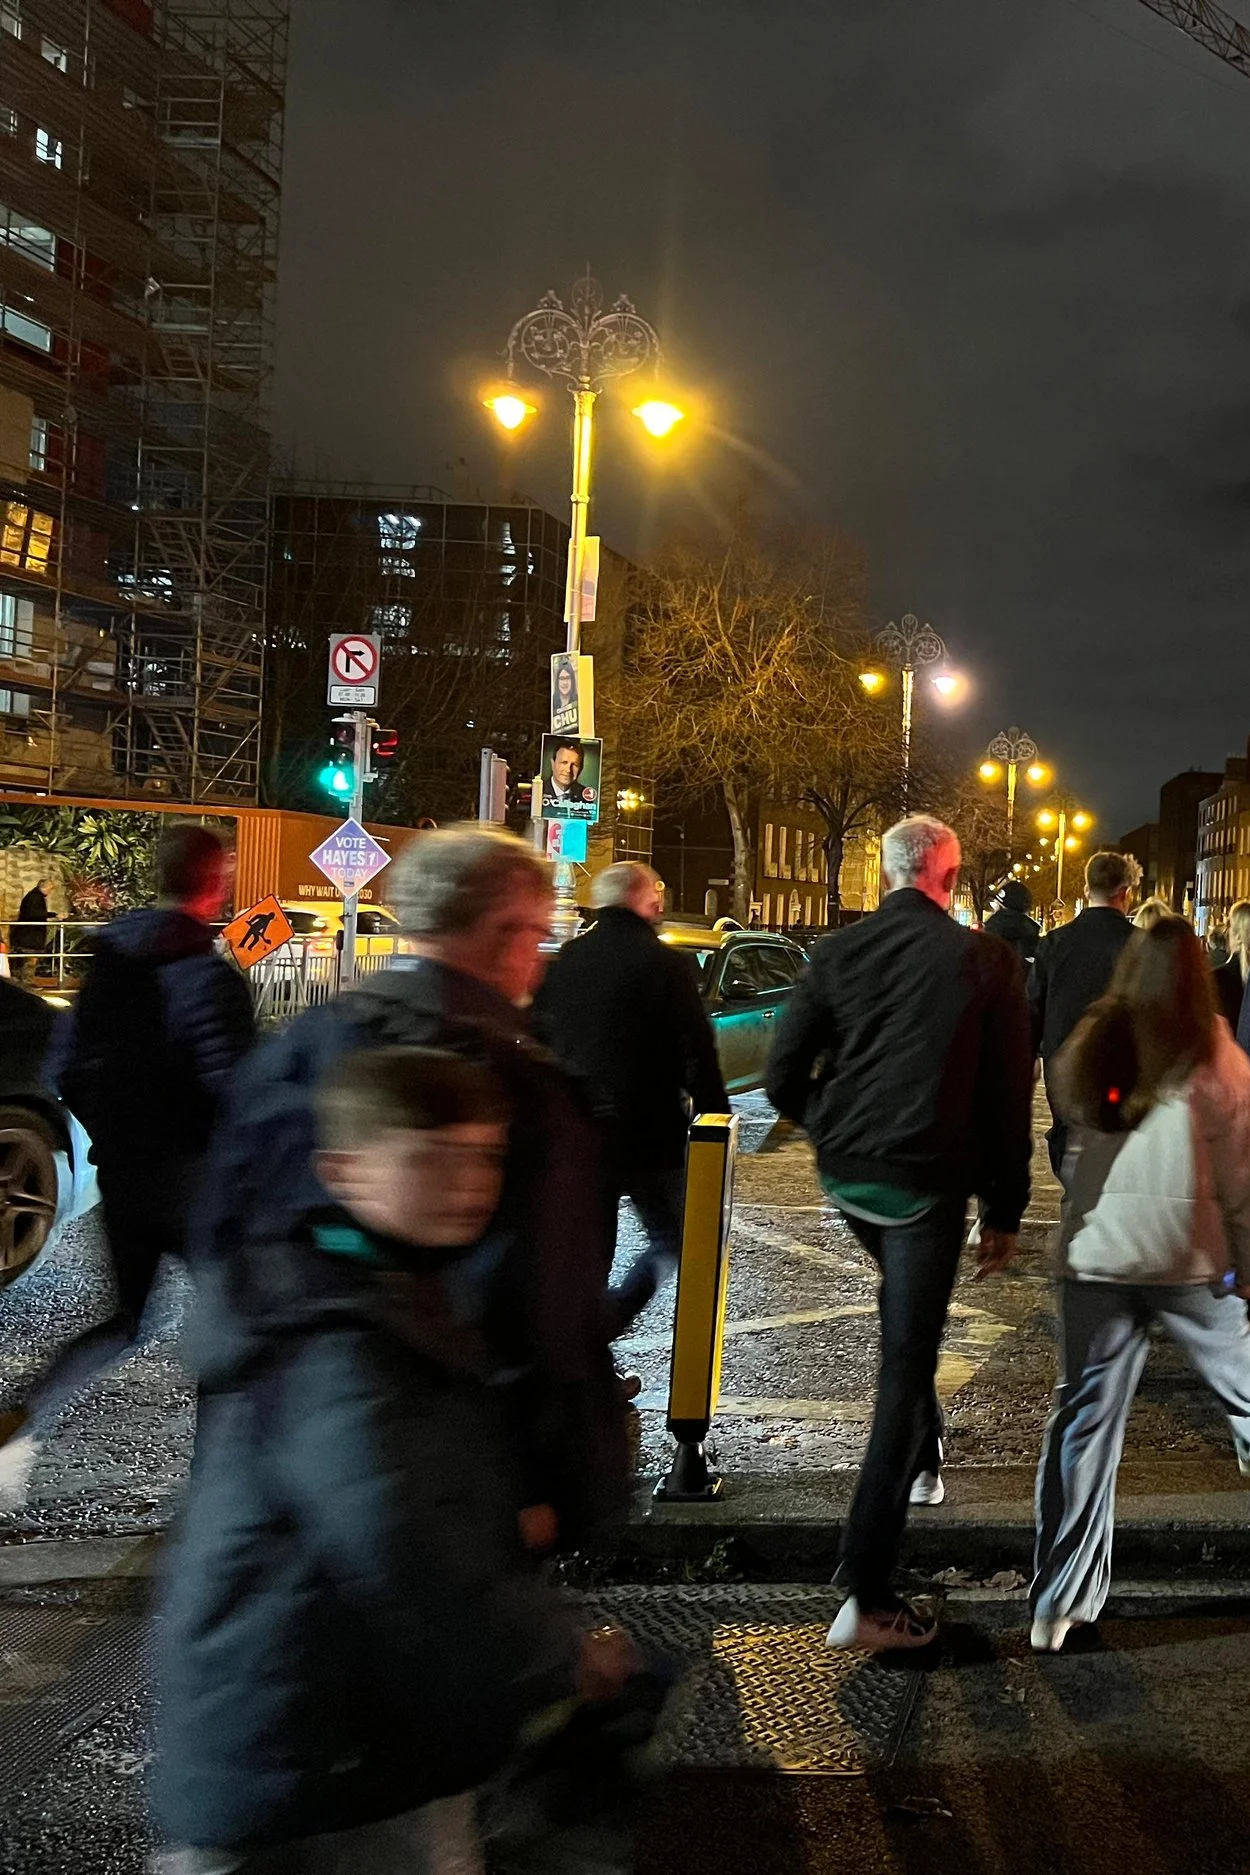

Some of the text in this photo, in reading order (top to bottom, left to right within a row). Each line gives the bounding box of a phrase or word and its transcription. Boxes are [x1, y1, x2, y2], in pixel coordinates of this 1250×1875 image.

[553, 708, 578, 729] CHU
[335, 837, 367, 849] VOTE
[322, 849, 376, 867] HAYES 1
[331, 867, 368, 879] TODAY
[298, 884, 316, 897] WHY
[316, 885, 335, 898] WAIT
[357, 888, 373, 900] 030
